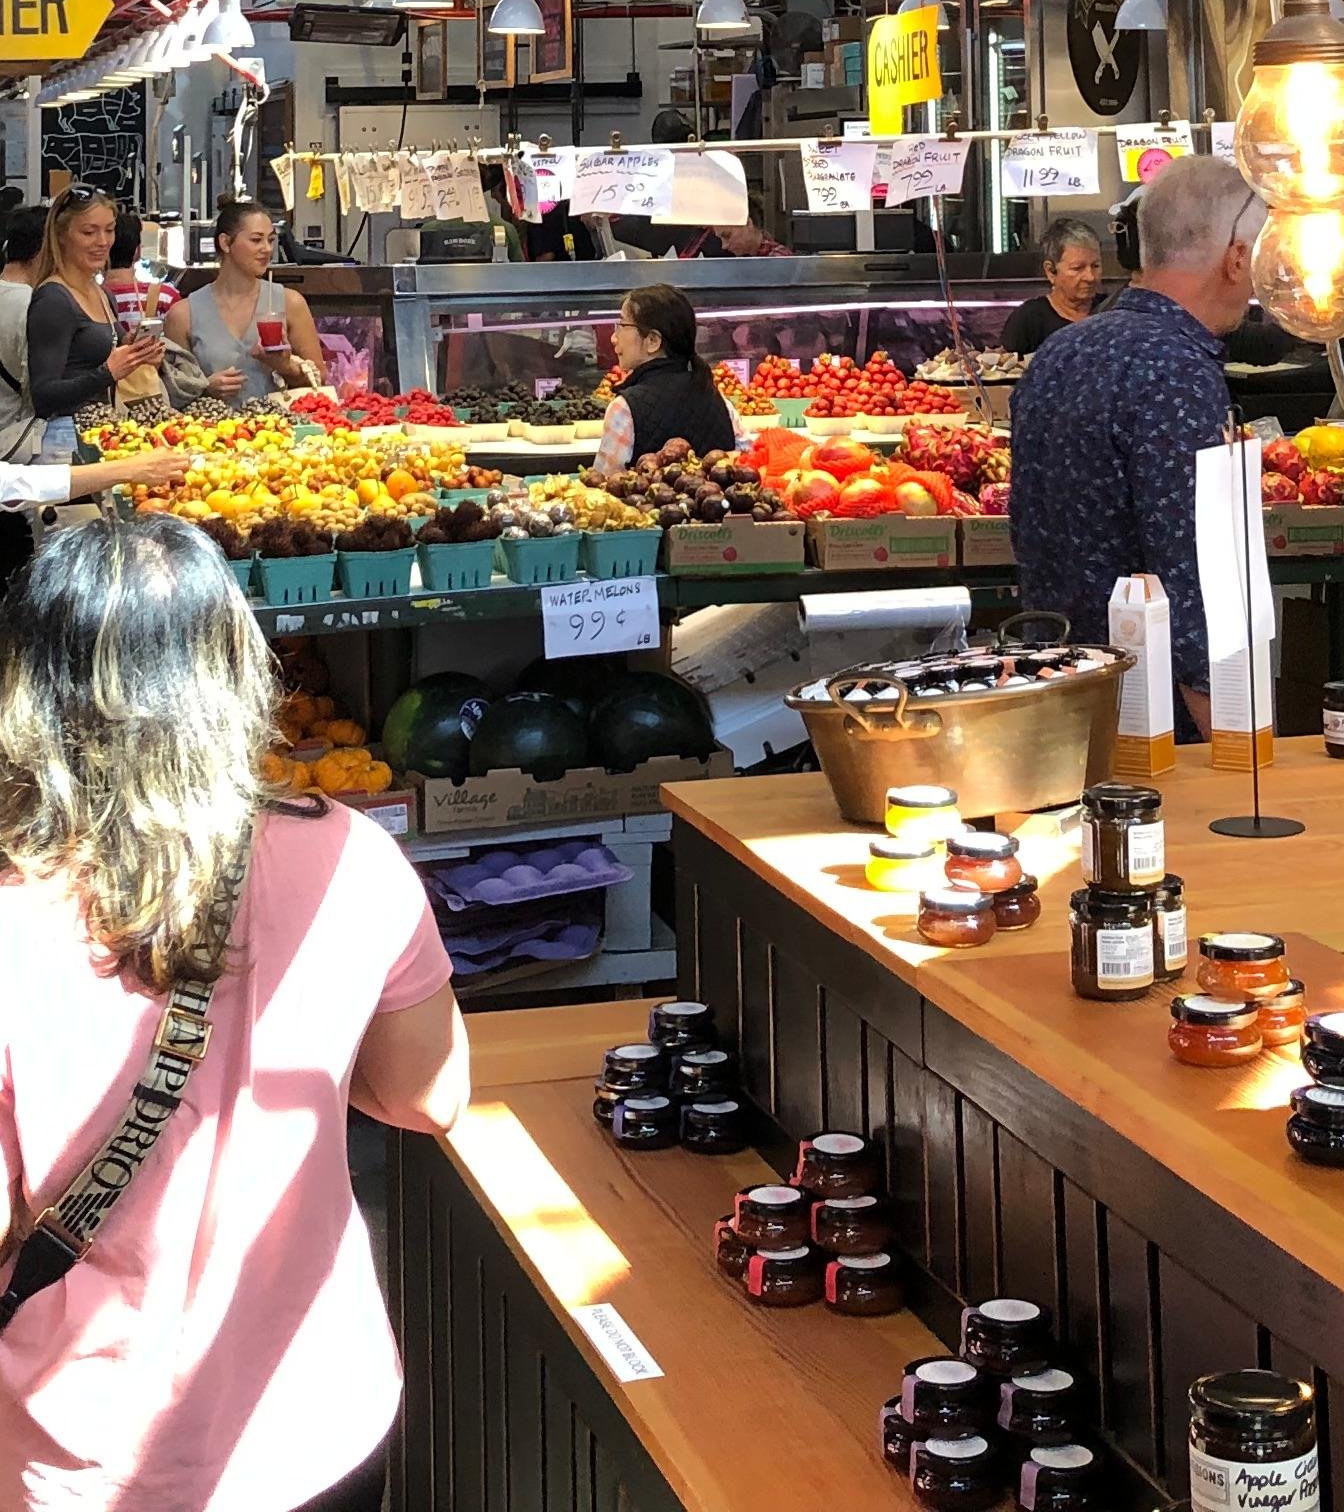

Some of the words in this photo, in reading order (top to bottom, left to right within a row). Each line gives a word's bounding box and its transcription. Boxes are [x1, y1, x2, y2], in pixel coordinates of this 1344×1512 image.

[874, 29, 929, 88] CASHIER
[924, 152, 961, 163] FRUIT
[1006, 145, 1044, 157] DRAGON
[1049, 145, 1082, 157] FRUIT
[594, 582, 641, 601] MELONS
[433, 788, 498, 810] Village
[1235, 1468, 1288, 1493] Apple
